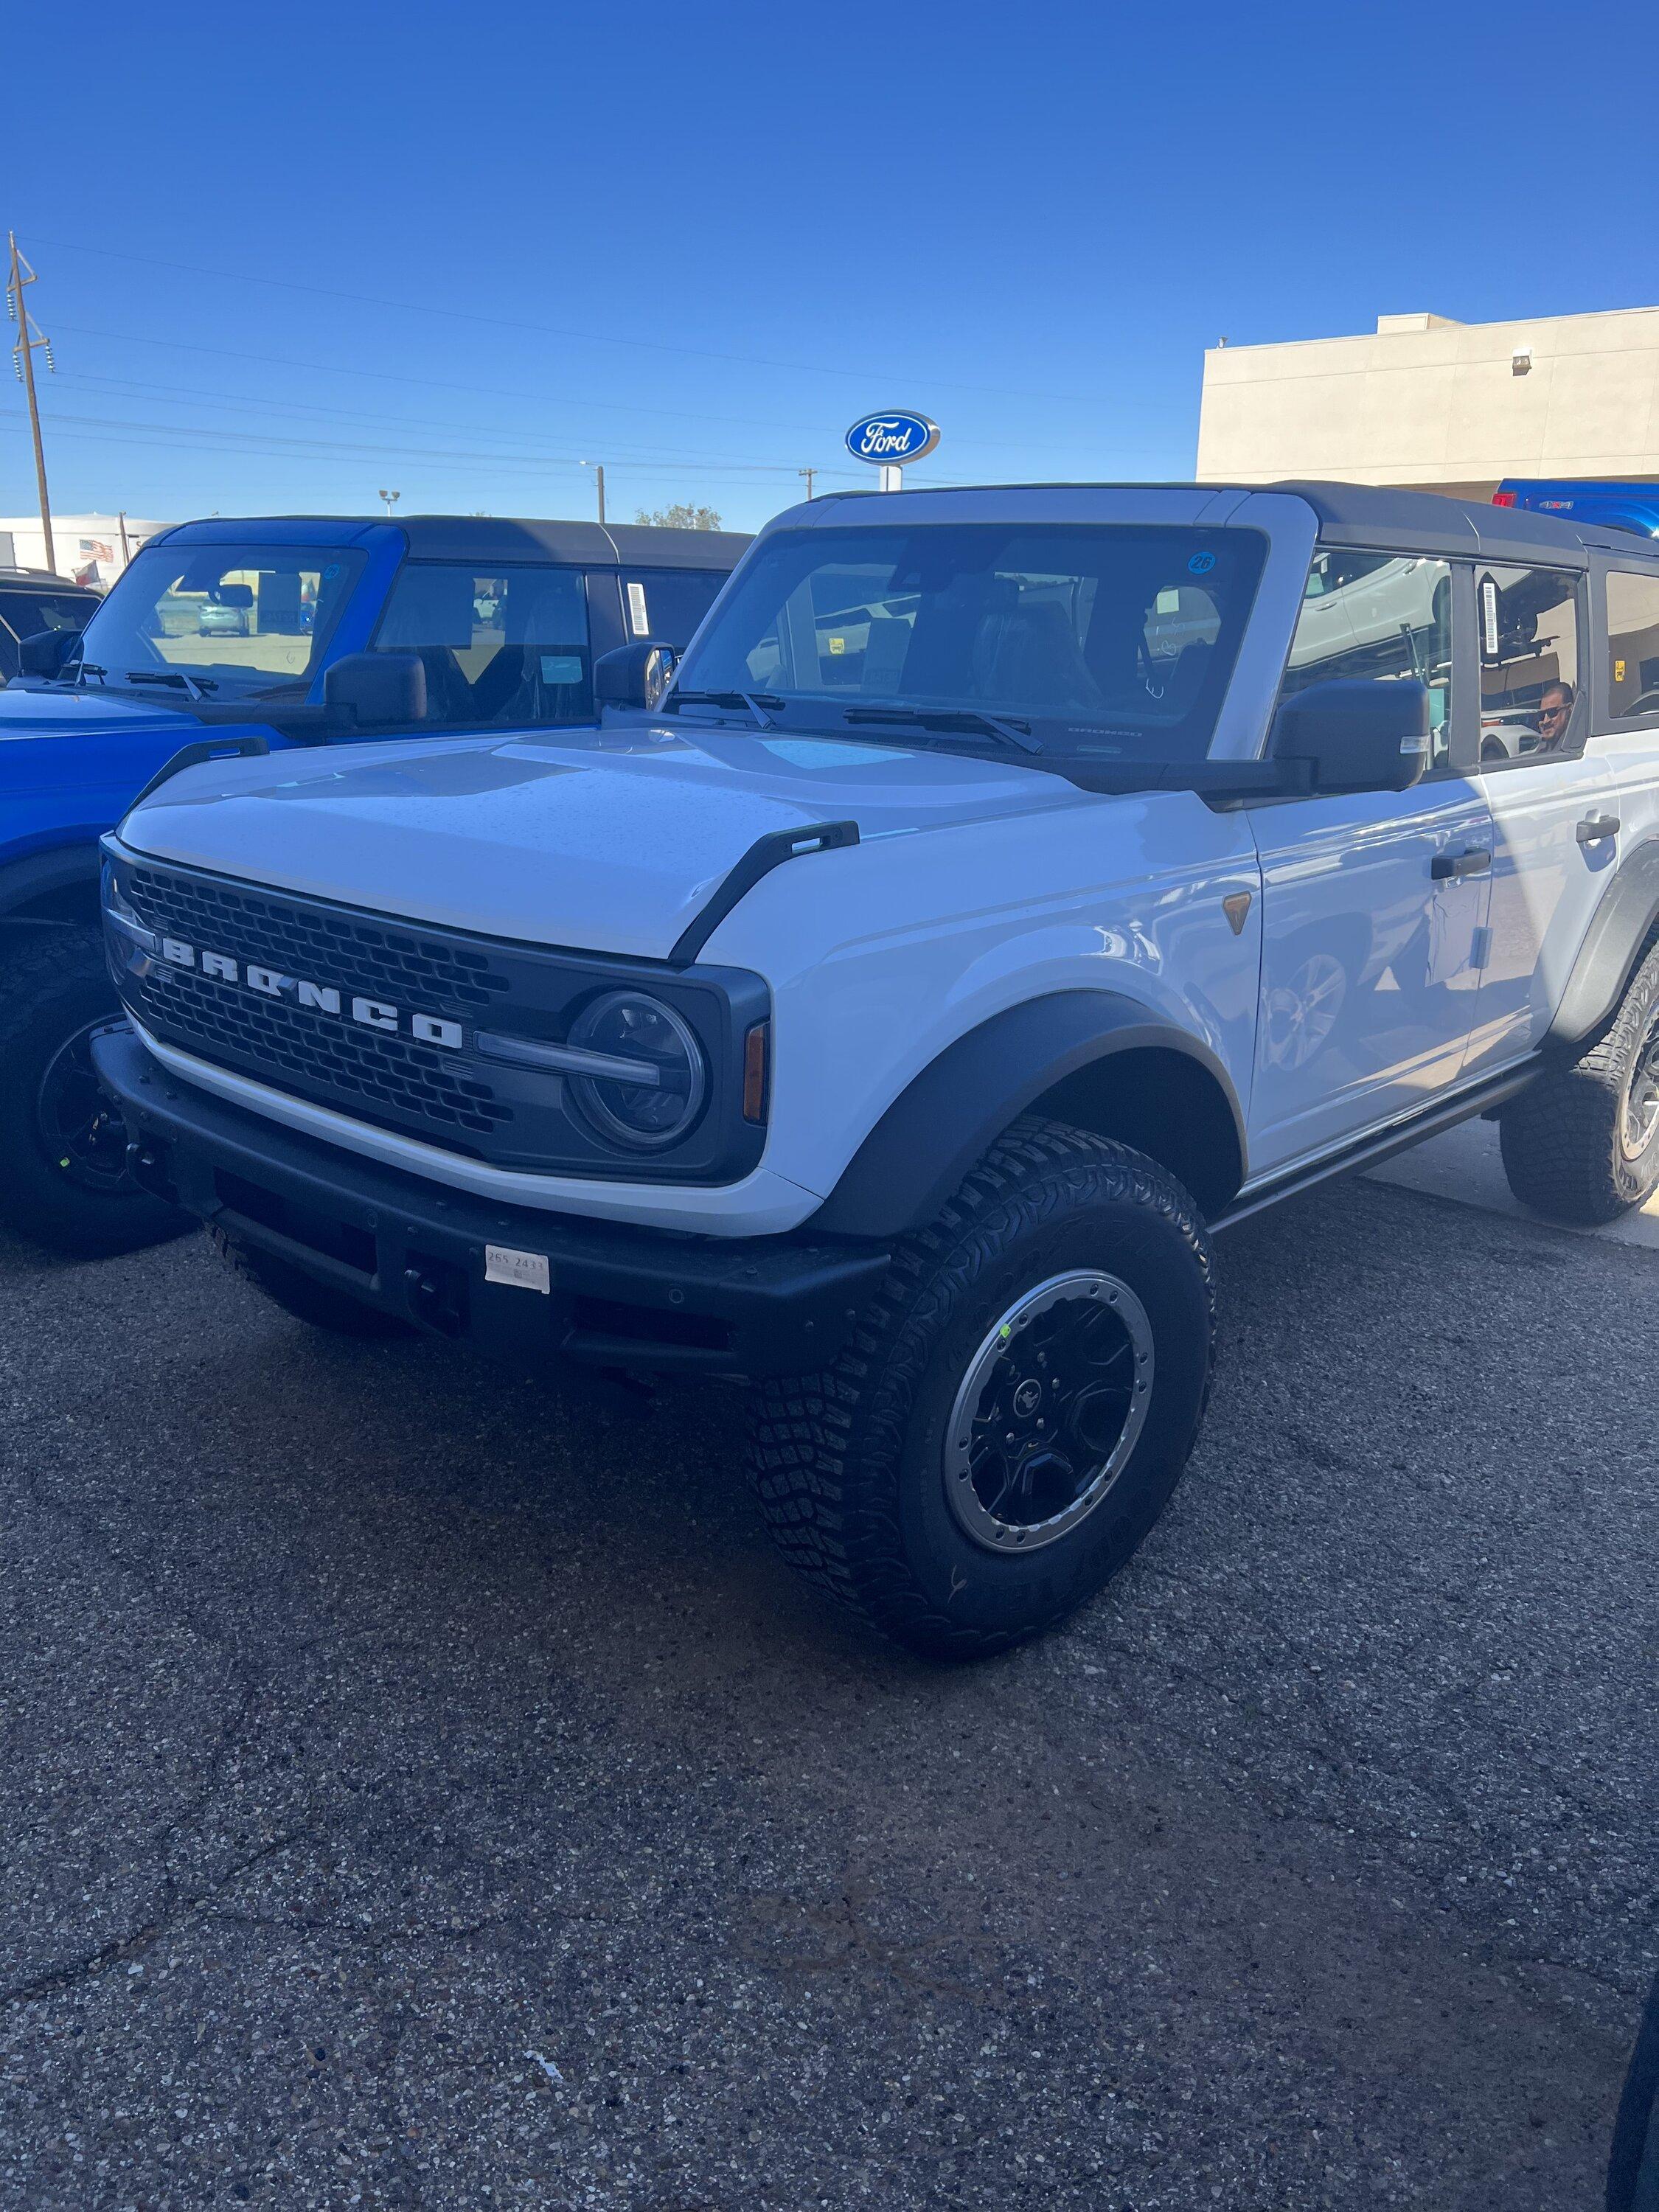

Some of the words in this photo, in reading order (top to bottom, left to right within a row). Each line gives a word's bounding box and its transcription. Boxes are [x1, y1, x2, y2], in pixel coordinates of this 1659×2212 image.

[860, 422, 913, 453] Ford
[162, 937, 462, 1049] BRONCO
[488, 1251, 509, 1264] 265
